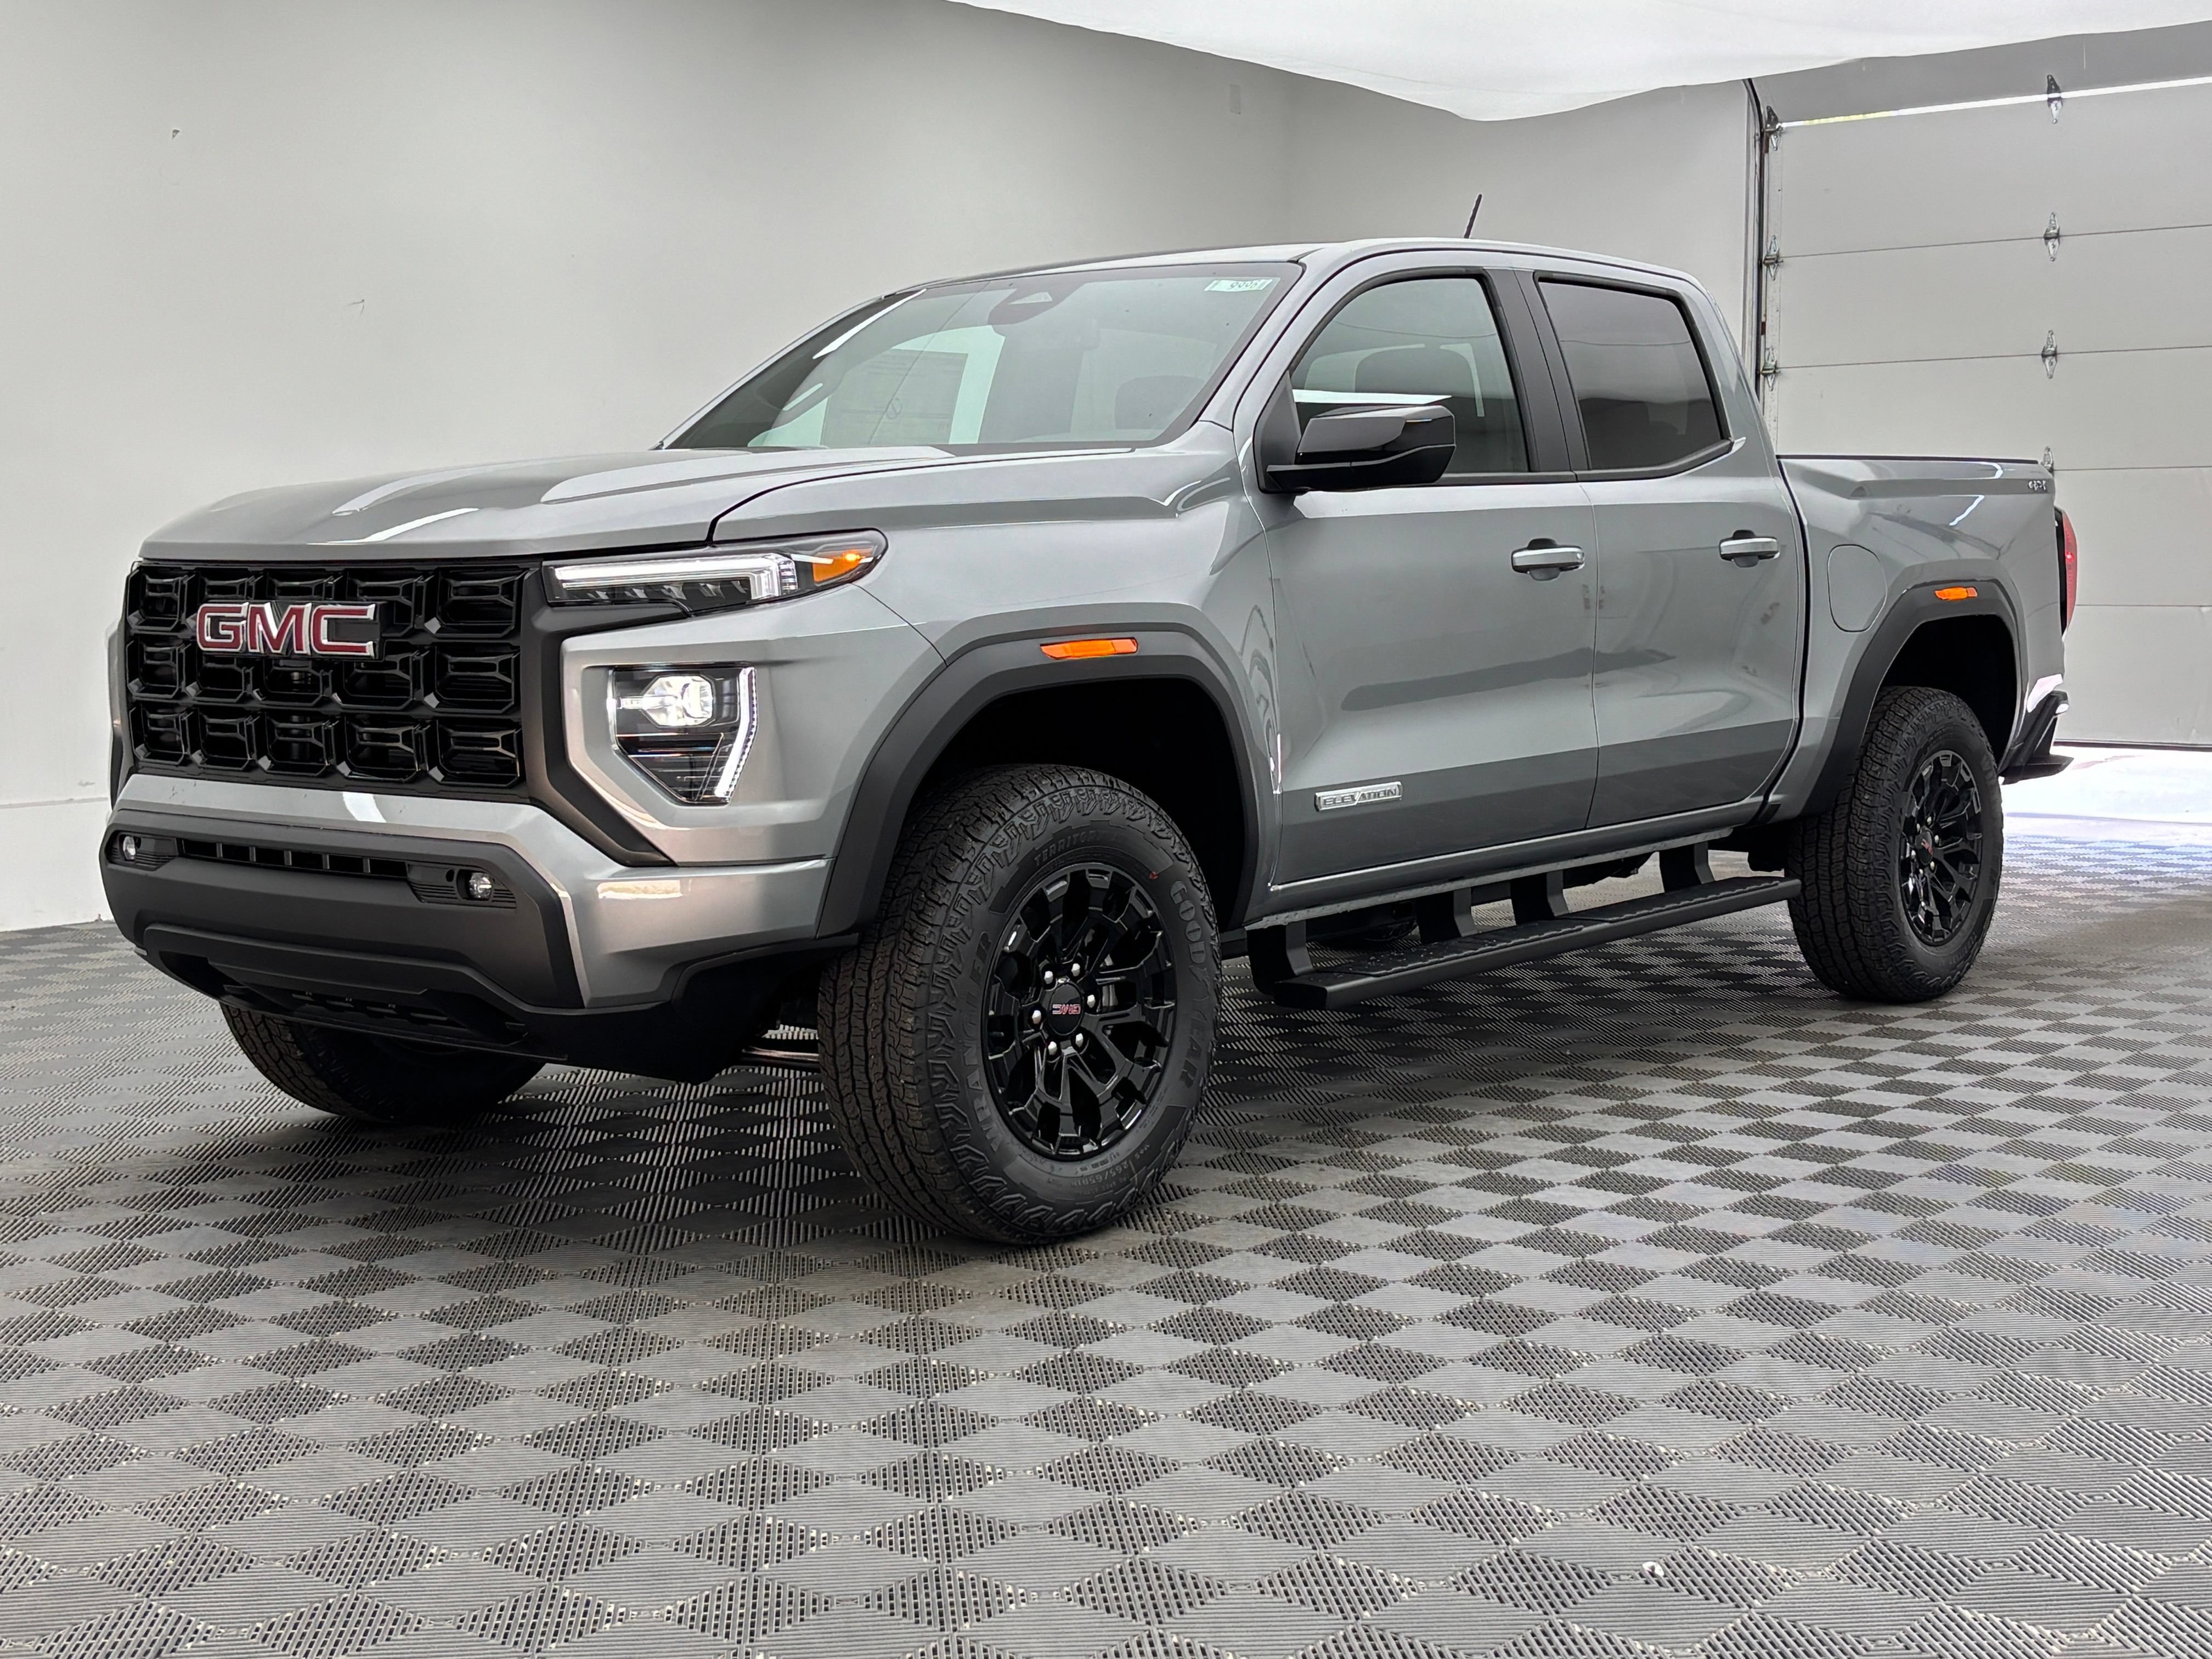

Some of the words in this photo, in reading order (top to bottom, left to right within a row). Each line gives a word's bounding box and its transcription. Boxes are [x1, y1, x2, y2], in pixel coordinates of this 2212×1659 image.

[197, 601, 375, 658] GMC
[1323, 788, 1397, 805] ELEVATION
[1052, 1003, 1081, 1014] GMC
